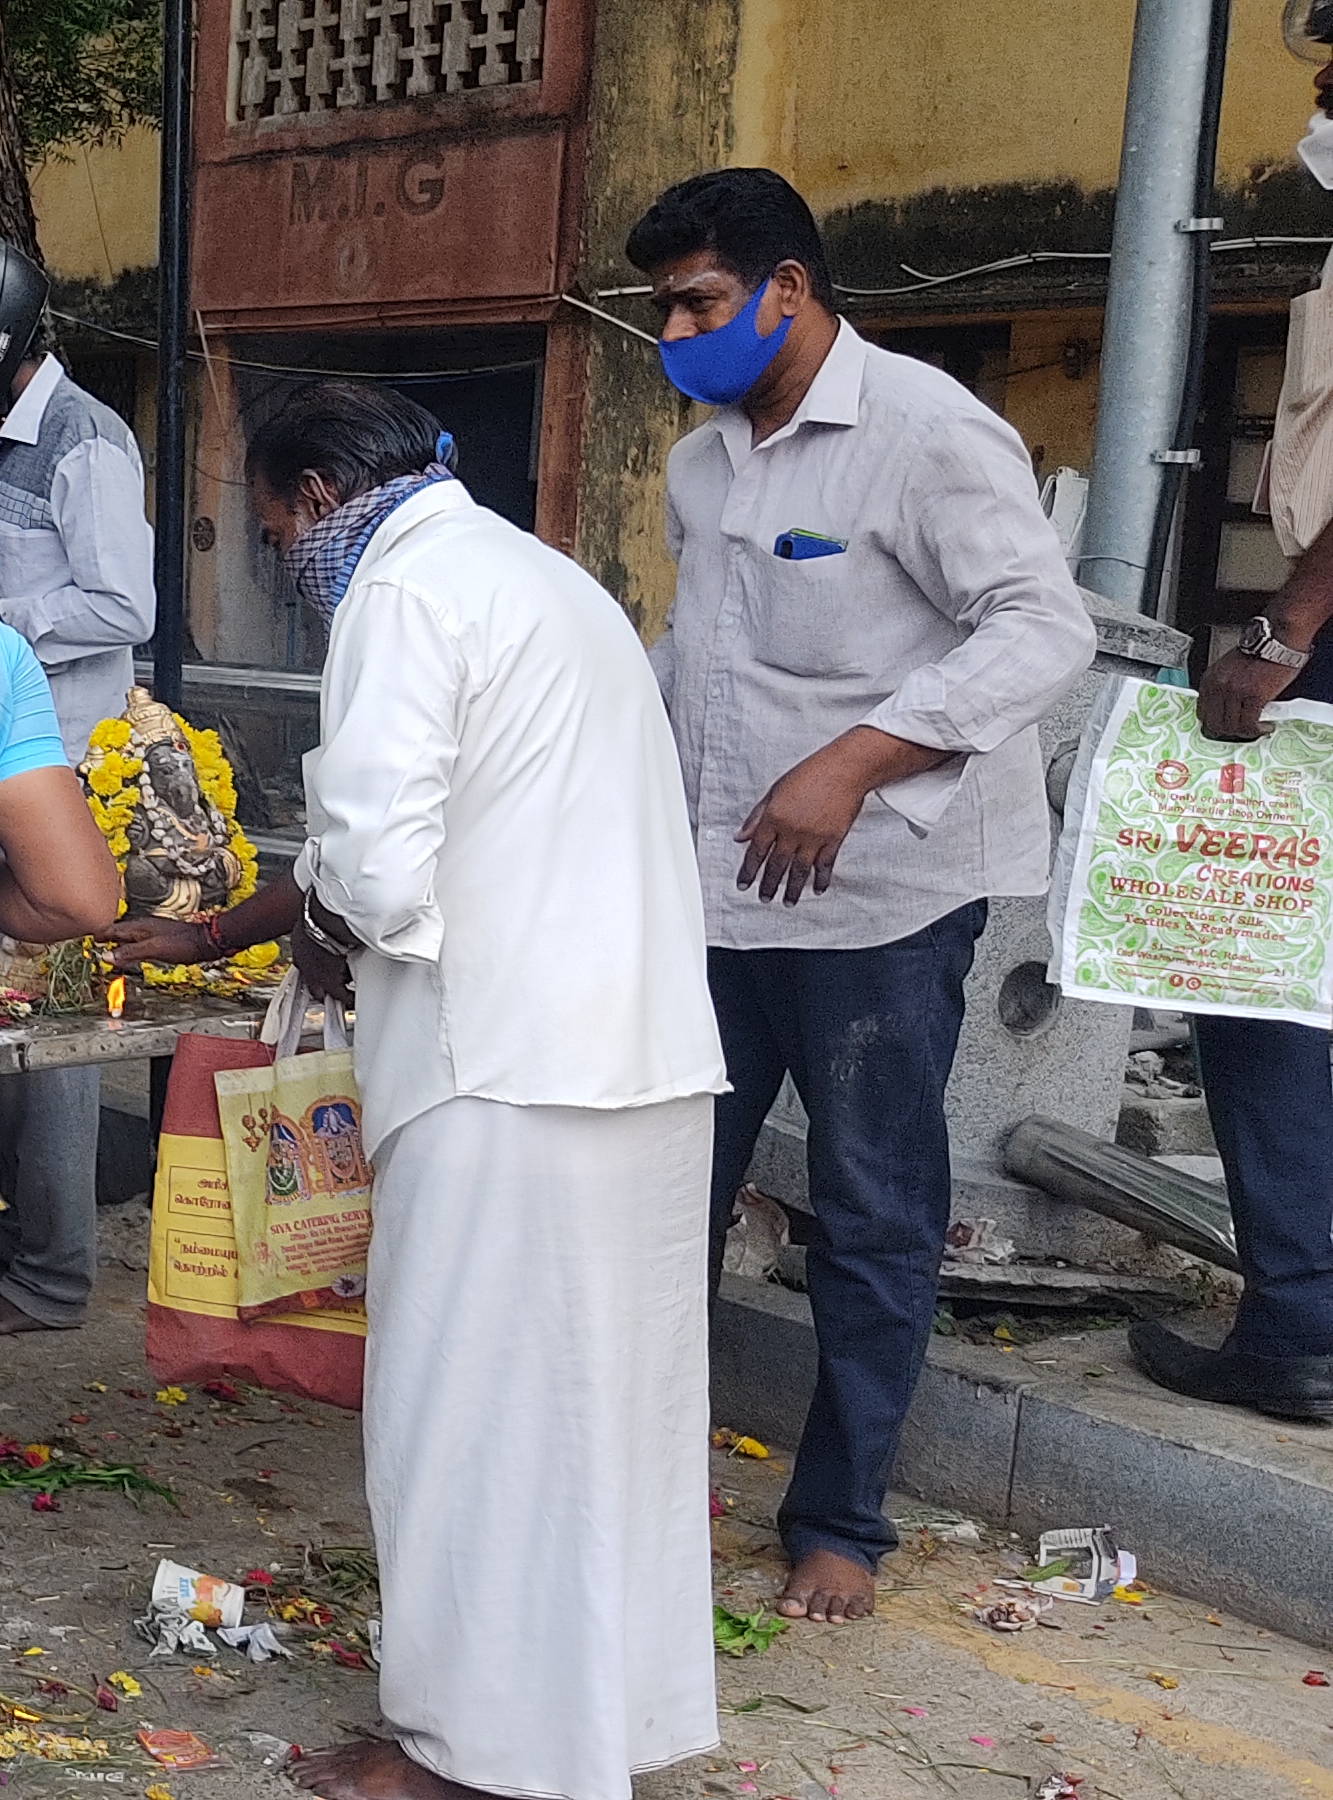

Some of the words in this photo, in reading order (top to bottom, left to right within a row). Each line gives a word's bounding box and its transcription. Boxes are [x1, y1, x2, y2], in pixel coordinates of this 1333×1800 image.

[1170, 792, 1197, 803] Only
[1158, 803, 1186, 814] Many
[1228, 809, 1253, 820] Shop
[1256, 811, 1296, 822] Owners
[1116, 827, 1161, 854] SRI
[1175, 824, 1321, 871] VEERA'S
[1196, 864, 1315, 893] CREATIONS
[1109, 875, 1246, 906] WHOLESALE
[1253, 894, 1314, 912] SHOP
[1145, 905, 1215, 922] Collection
[1220, 914, 1234, 924] of
[1124, 913, 1180, 929] Textiles
[1184, 922, 1195, 932] &
[1200, 923, 1286, 942] Readymades
[269, 1222, 292, 1235] SIVA
[293, 1214, 340, 1231] CATERING
